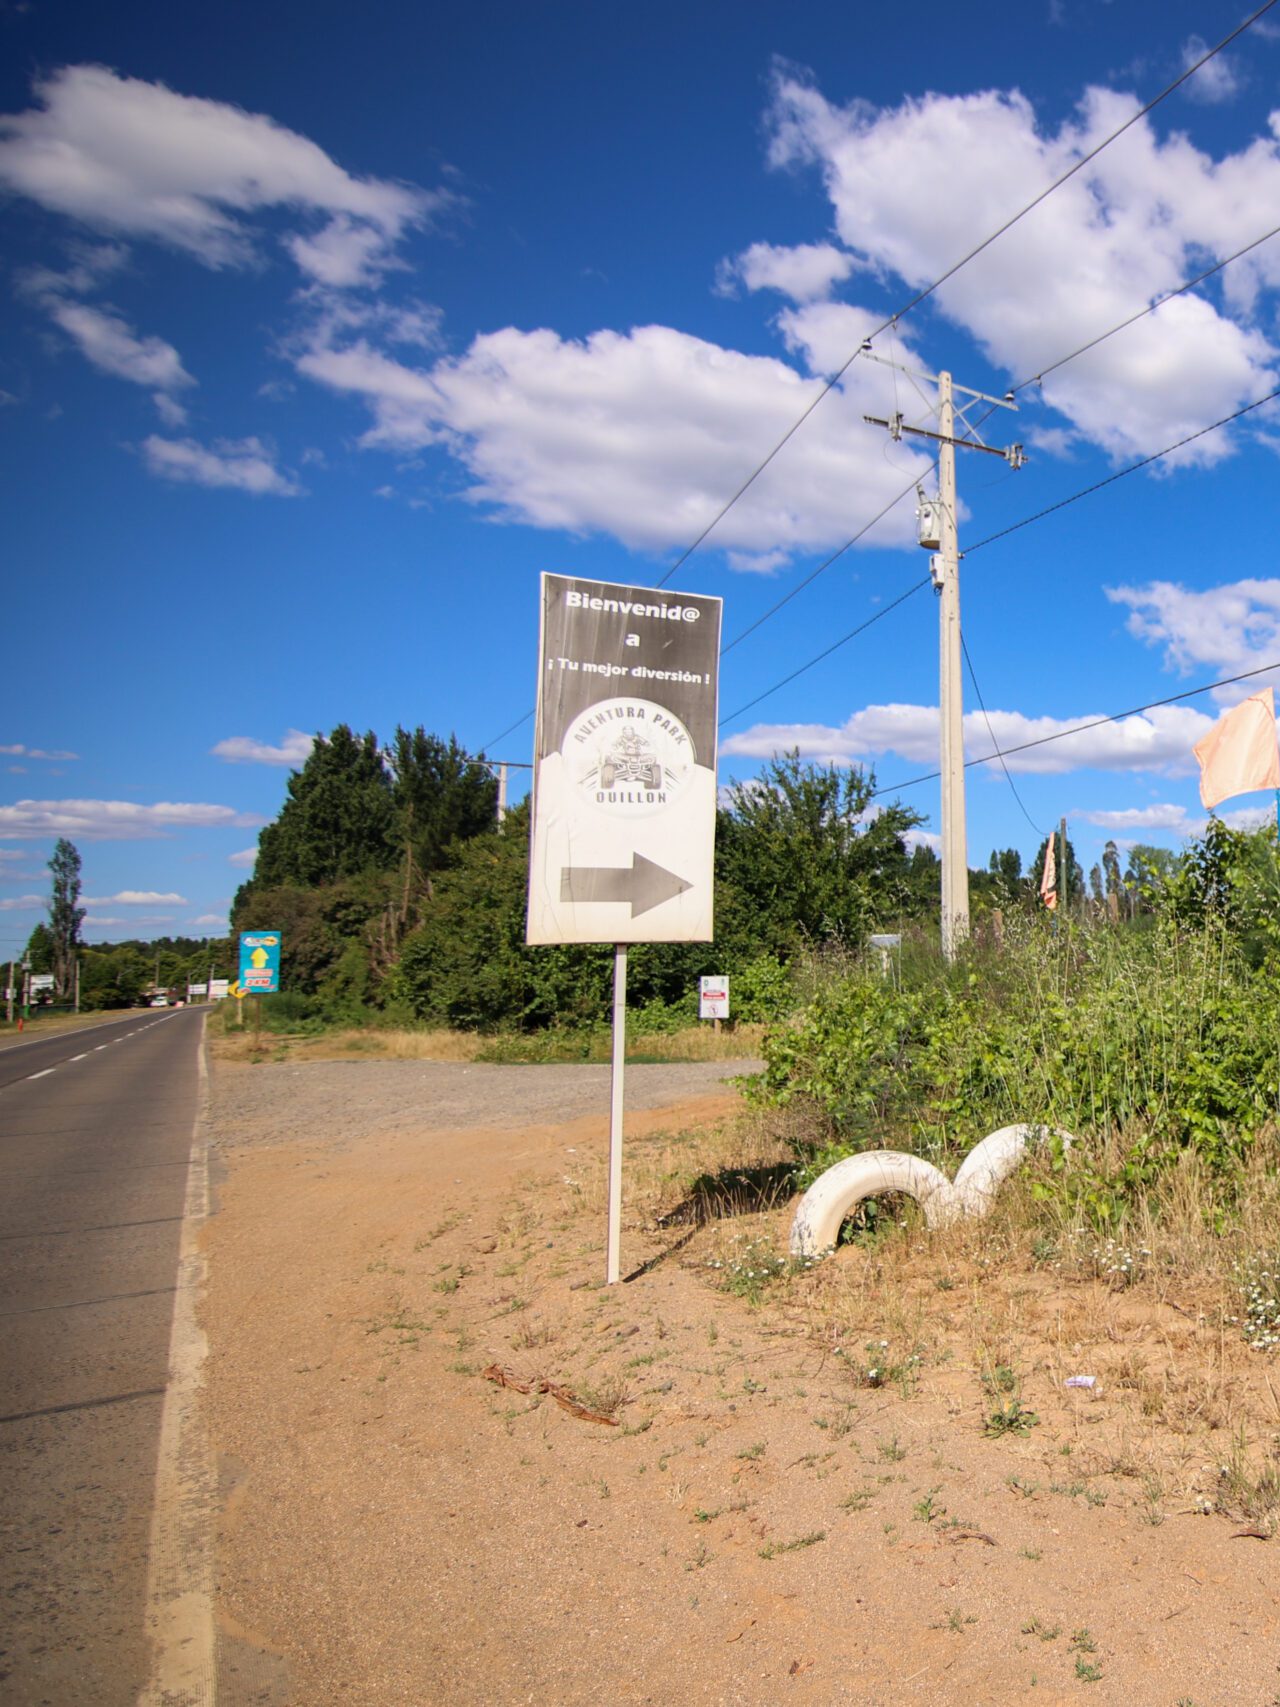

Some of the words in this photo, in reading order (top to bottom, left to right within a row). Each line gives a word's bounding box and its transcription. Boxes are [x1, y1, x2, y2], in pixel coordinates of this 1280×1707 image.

[565, 591, 700, 622] Bienvenid@
[626, 633, 640, 647] a
[557, 658, 579, 670] Tu
[582, 662, 628, 677] mejor
[631, 666, 702, 684] diversión
[574, 707, 645, 744] AVENTURA
[653, 713, 689, 745] PARK
